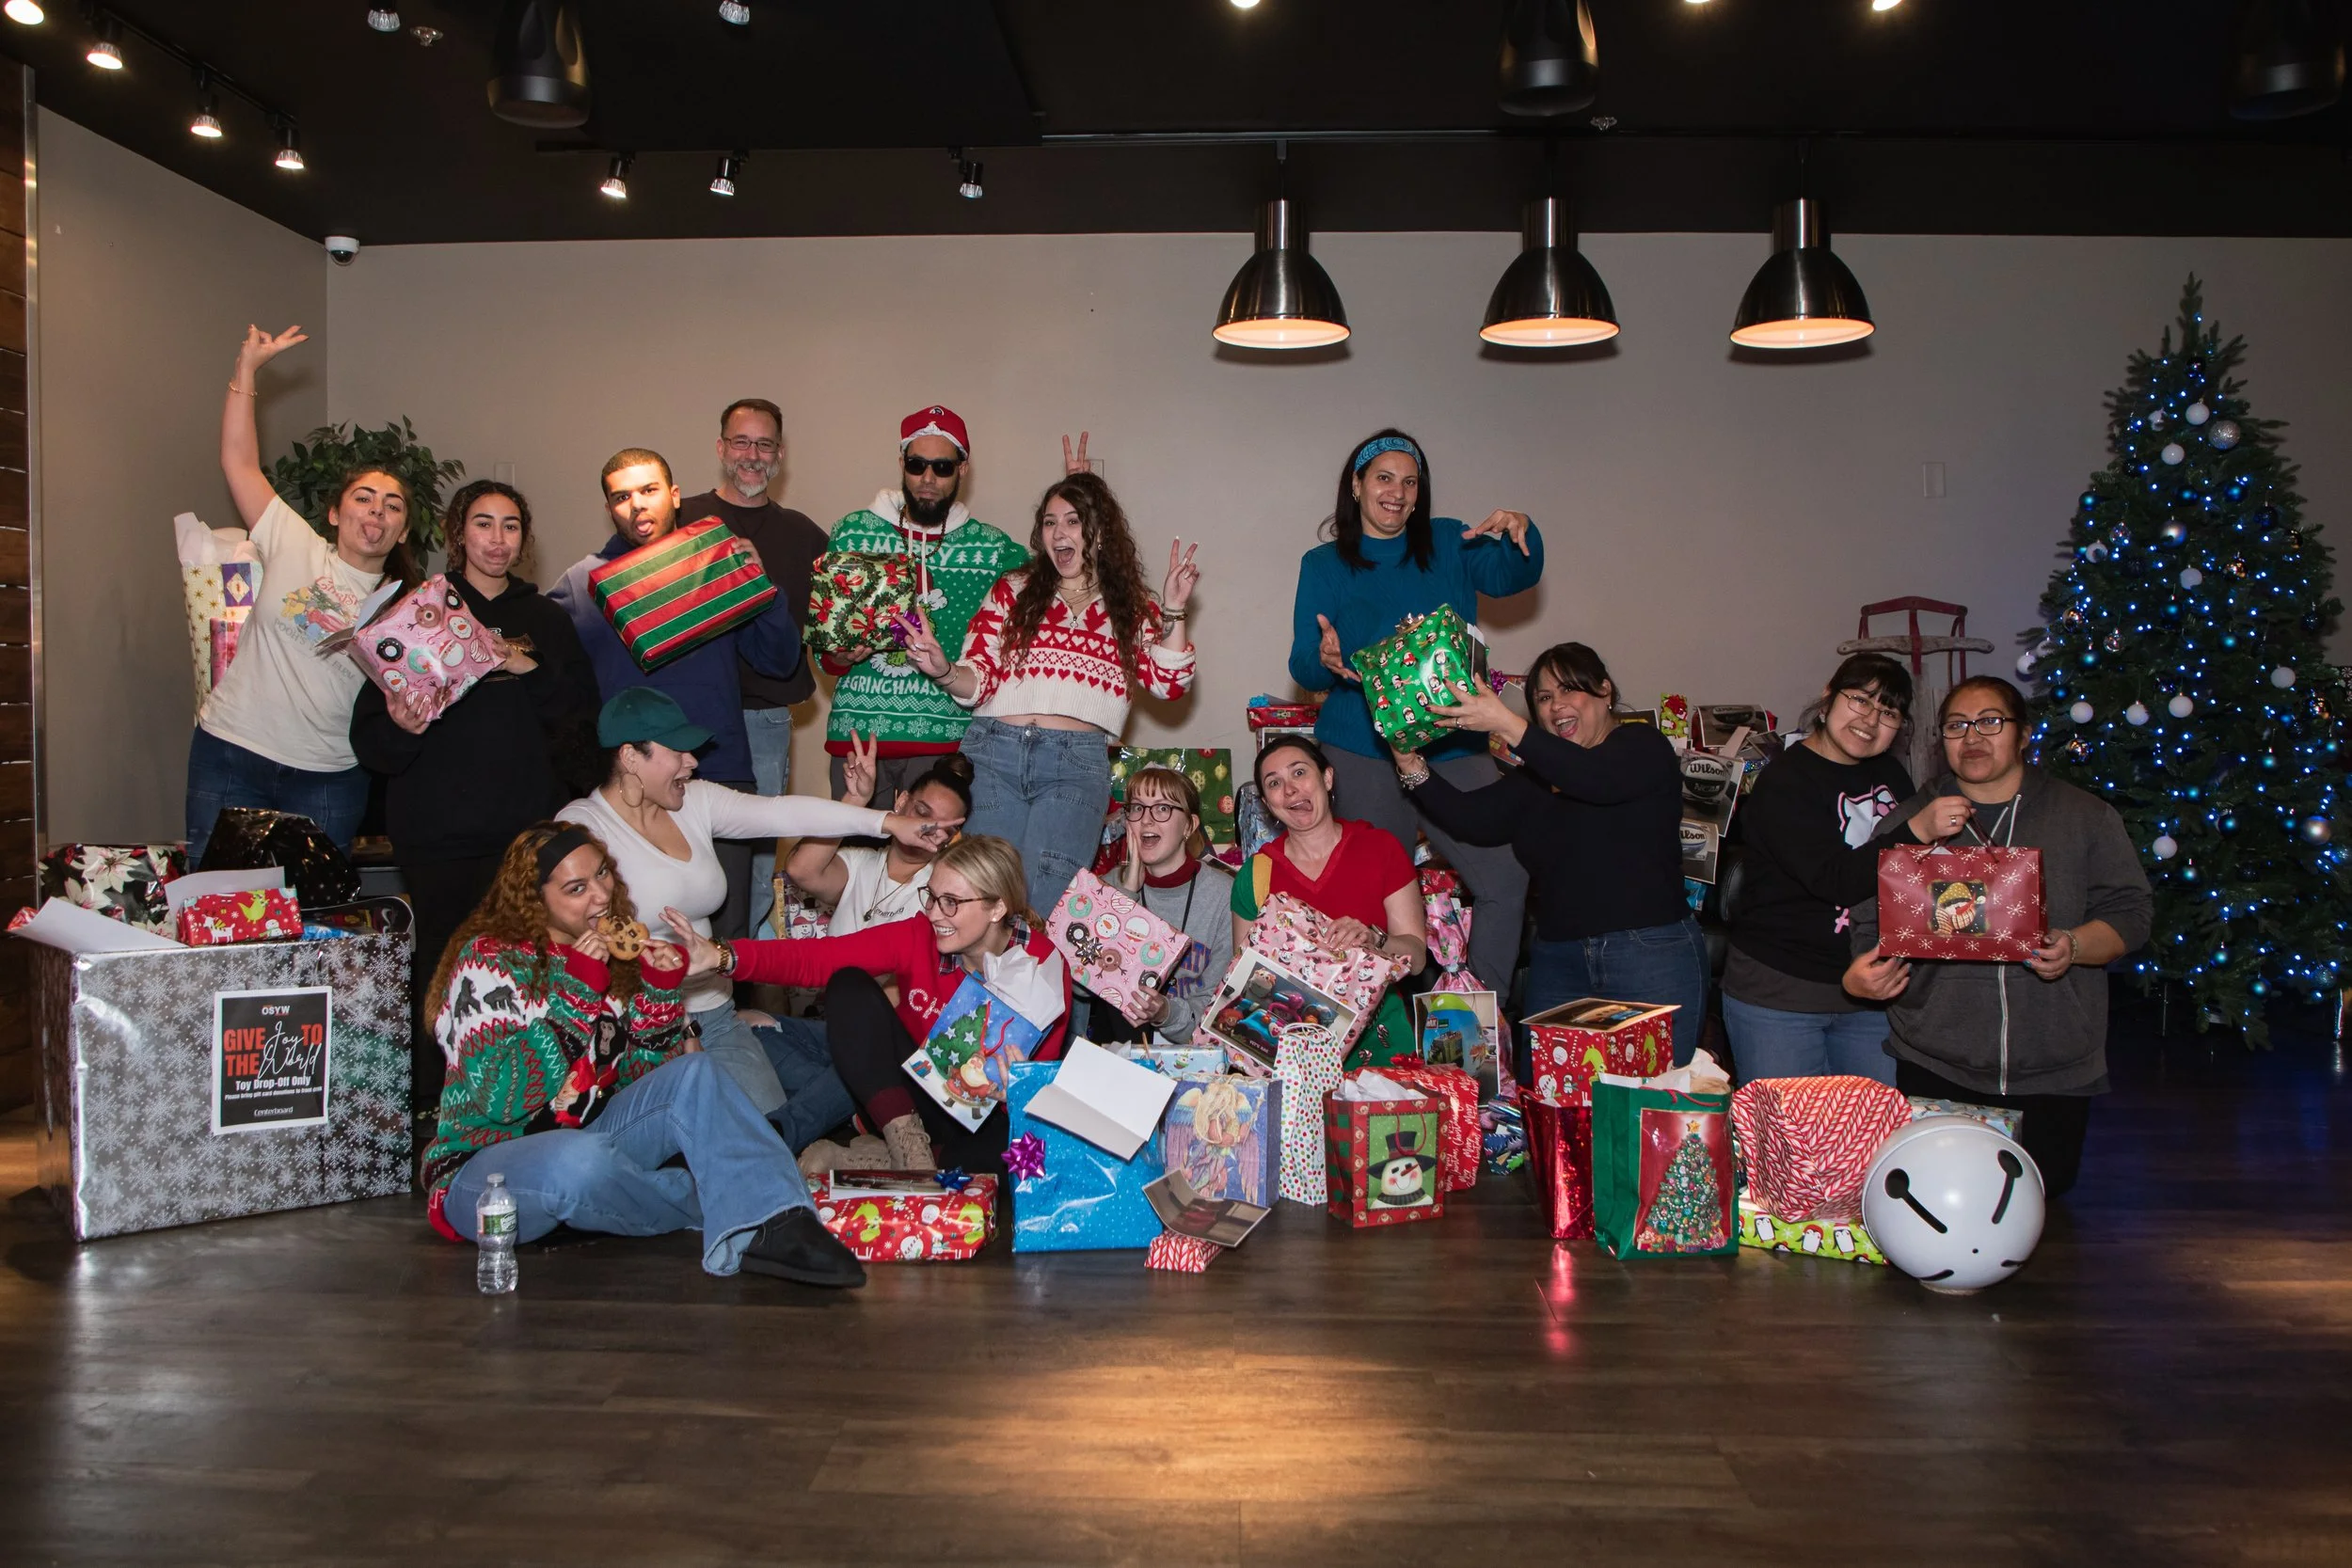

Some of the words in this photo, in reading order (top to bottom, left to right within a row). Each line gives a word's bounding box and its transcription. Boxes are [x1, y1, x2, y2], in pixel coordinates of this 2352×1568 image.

[1690, 763, 1724, 776] Wilson
[262, 1006, 290, 1015] OSYW
[223, 1027, 265, 1052] GIVE
[263, 1021, 305, 1064] Joy
[301, 1023, 323, 1046] TO
[225, 1053, 261, 1077] THE
[258, 1042, 322, 1080] World
[236, 1080, 252, 1091] Toy
[253, 1076, 290, 1090] Drop-Off
[292, 1075, 311, 1086] Only
[254, 1106, 294, 1117] Centerboard
